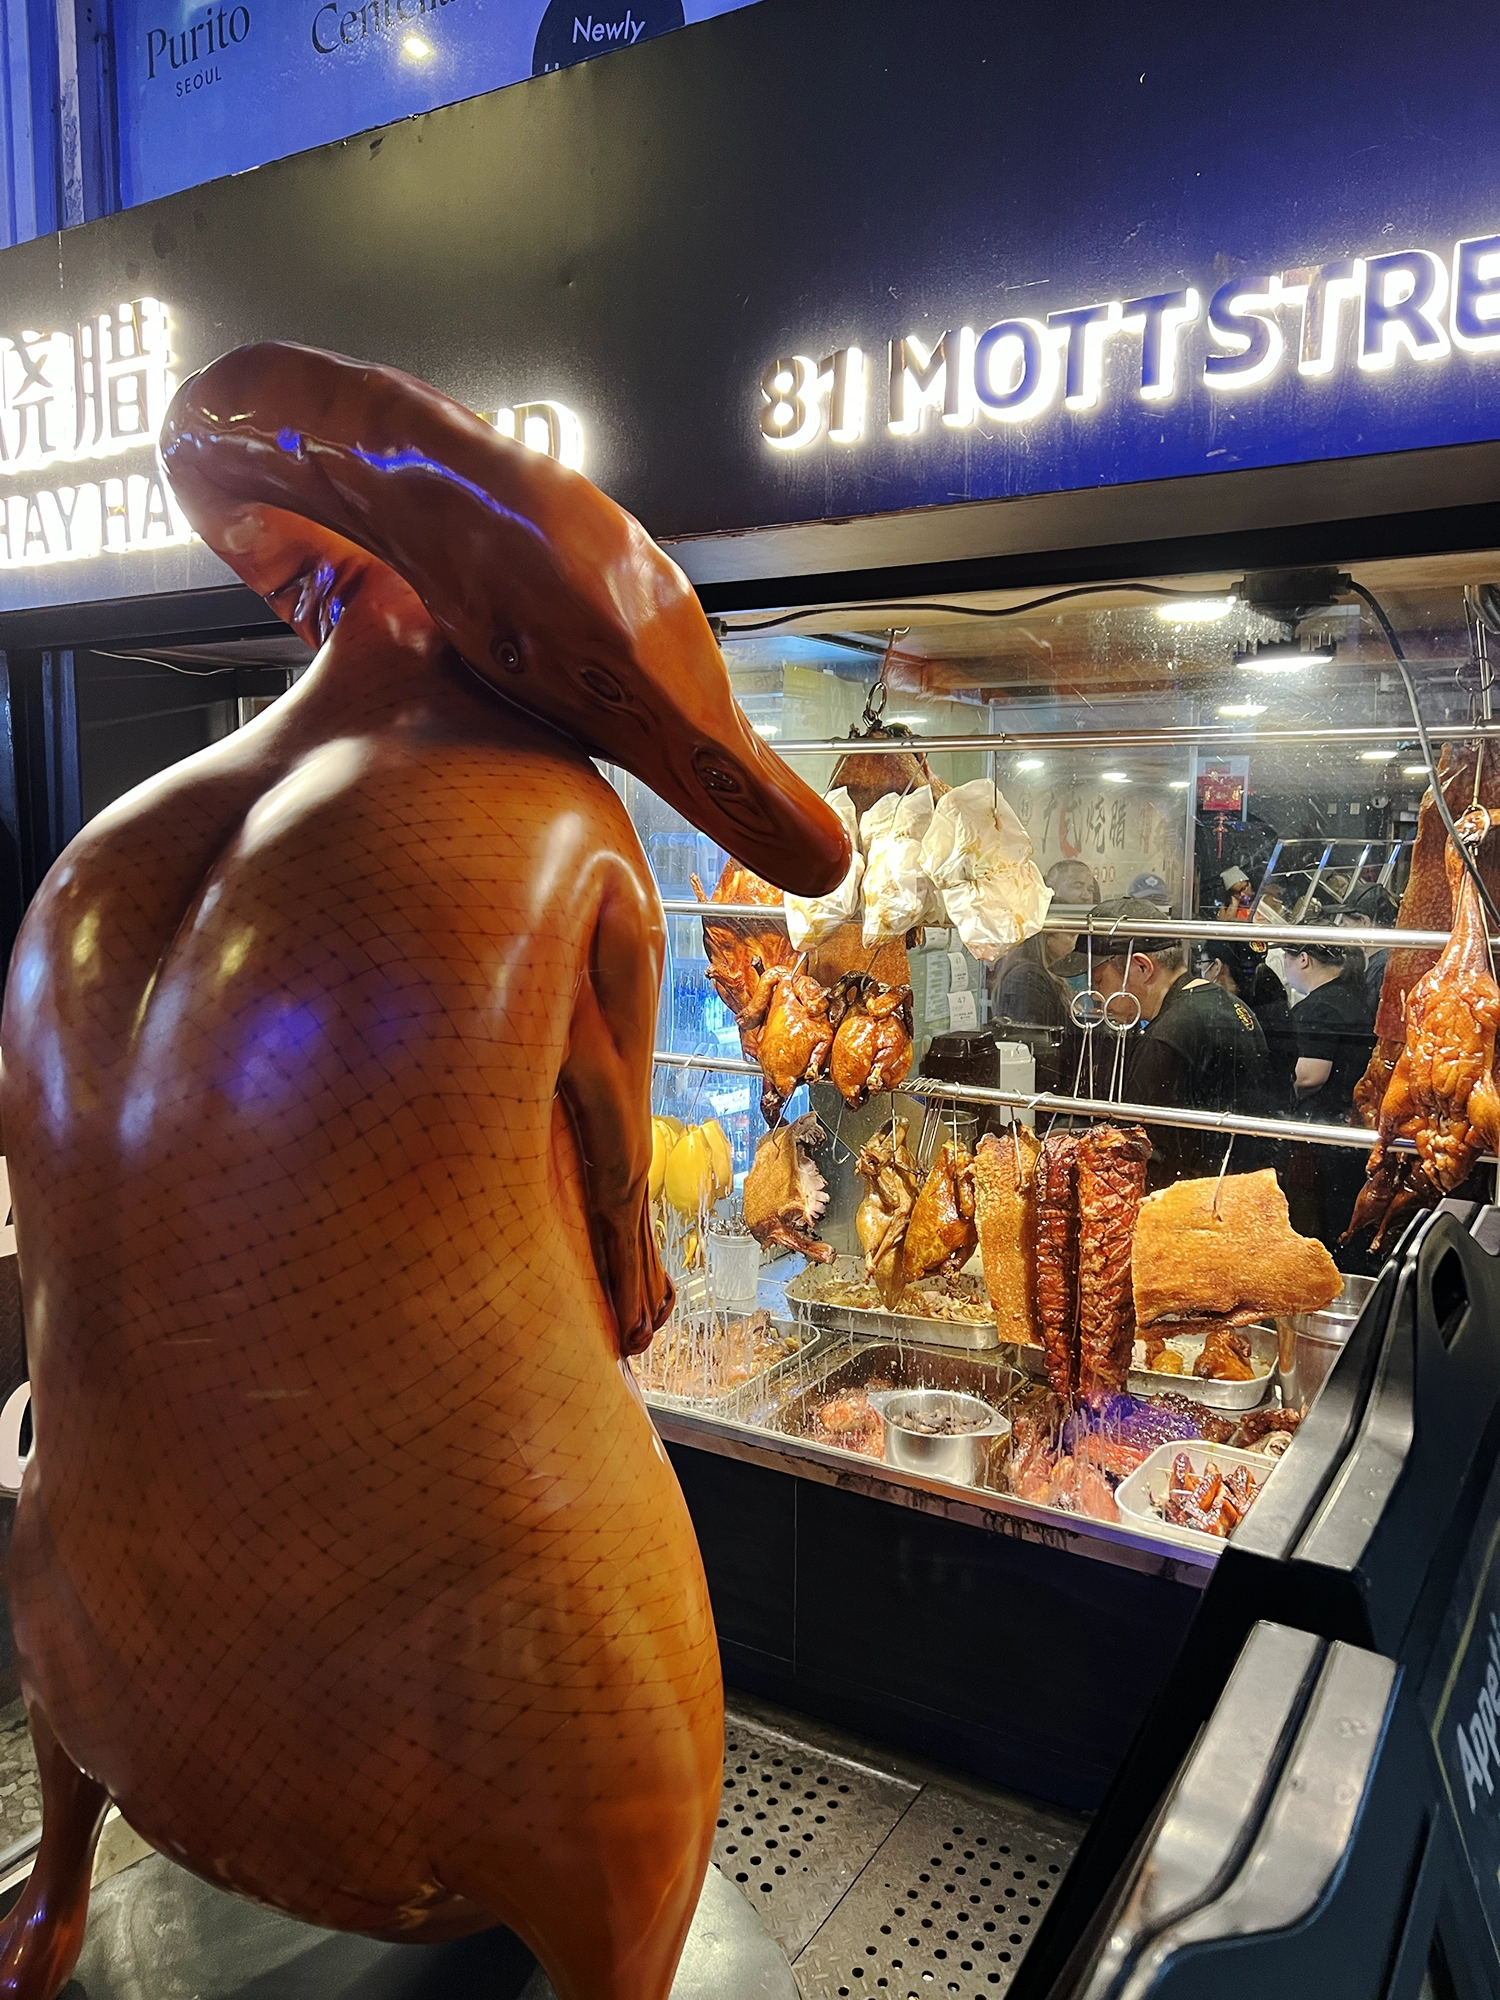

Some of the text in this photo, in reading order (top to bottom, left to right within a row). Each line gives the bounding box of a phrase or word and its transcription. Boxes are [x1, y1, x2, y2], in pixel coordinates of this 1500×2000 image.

[146, 5, 251, 81] Purito
[572, 10, 646, 44] Newly
[175, 65, 222, 98] SEOUL
[760, 347, 864, 449] 81
[886, 288, 1196, 433] MOTT
[0, 485, 84, 559] AY
[100, 470, 178, 547] HA
